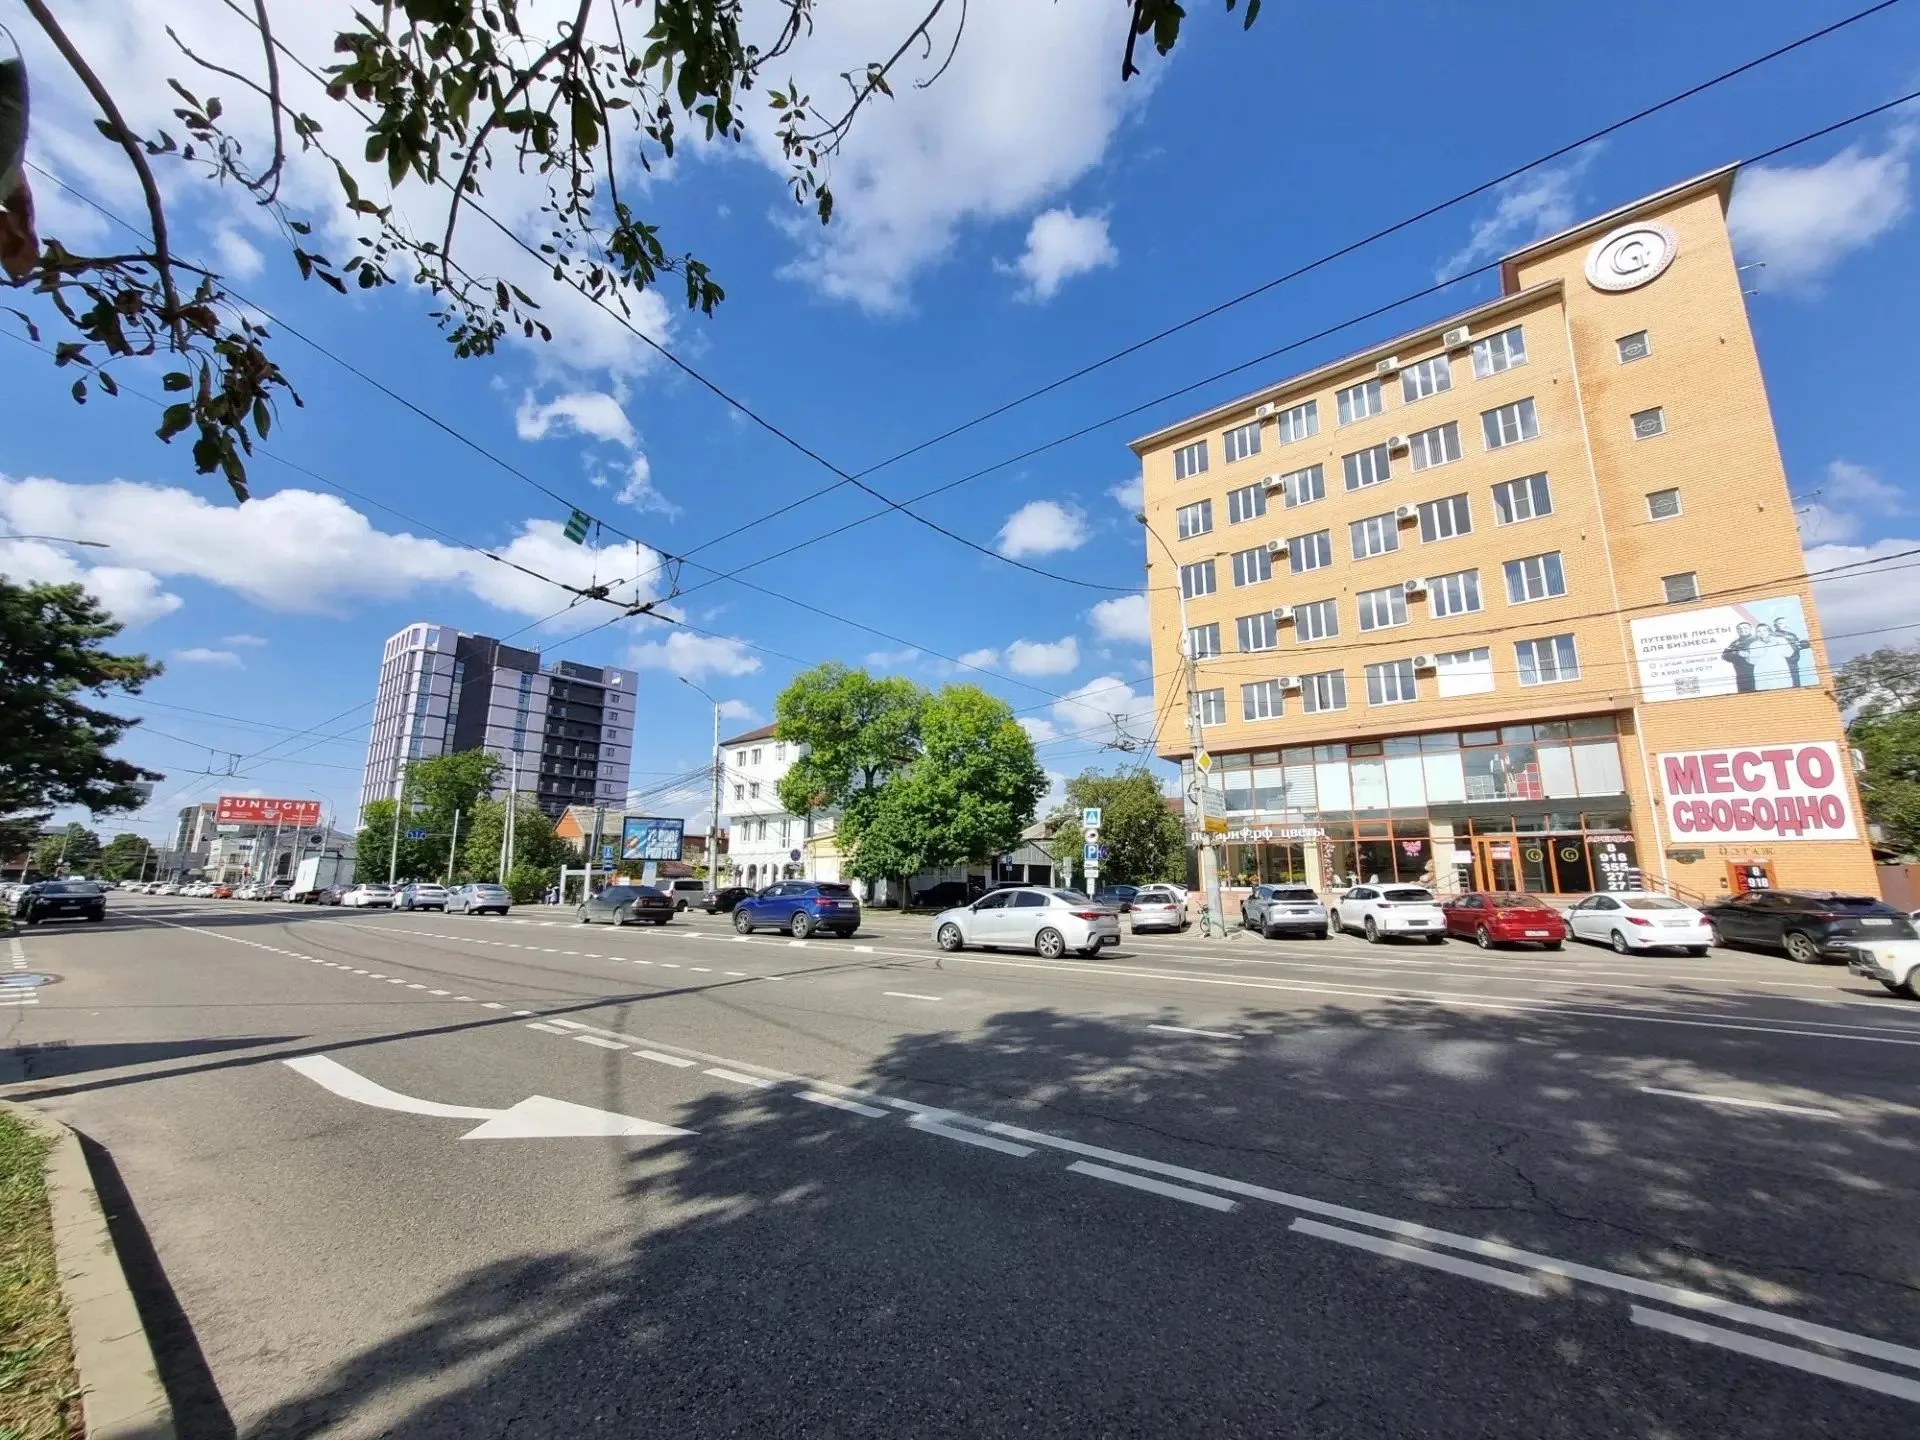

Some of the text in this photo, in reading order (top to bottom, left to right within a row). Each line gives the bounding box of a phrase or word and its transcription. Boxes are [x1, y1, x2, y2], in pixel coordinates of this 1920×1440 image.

[1640, 626, 1731, 644] ПУТЕВЫЕ ЛИСТЫ
[1643, 638, 1717, 654] ДЛЯ БИЗНЕСА
[1664, 747, 1835, 795] МЕСТО
[223, 799, 318, 811] SUNLIGHT
[1672, 795, 1845, 836] СВОБОДНО
[1606, 843, 1616, 852] 8
[1599, 852, 1628, 862] 918
[1601, 862, 1629, 871] 355
[1752, 866, 1760, 876] 8
[1606, 872, 1625, 880] 27
[1608, 881, 1626, 890] 27
[1747, 877, 1769, 888] 918
